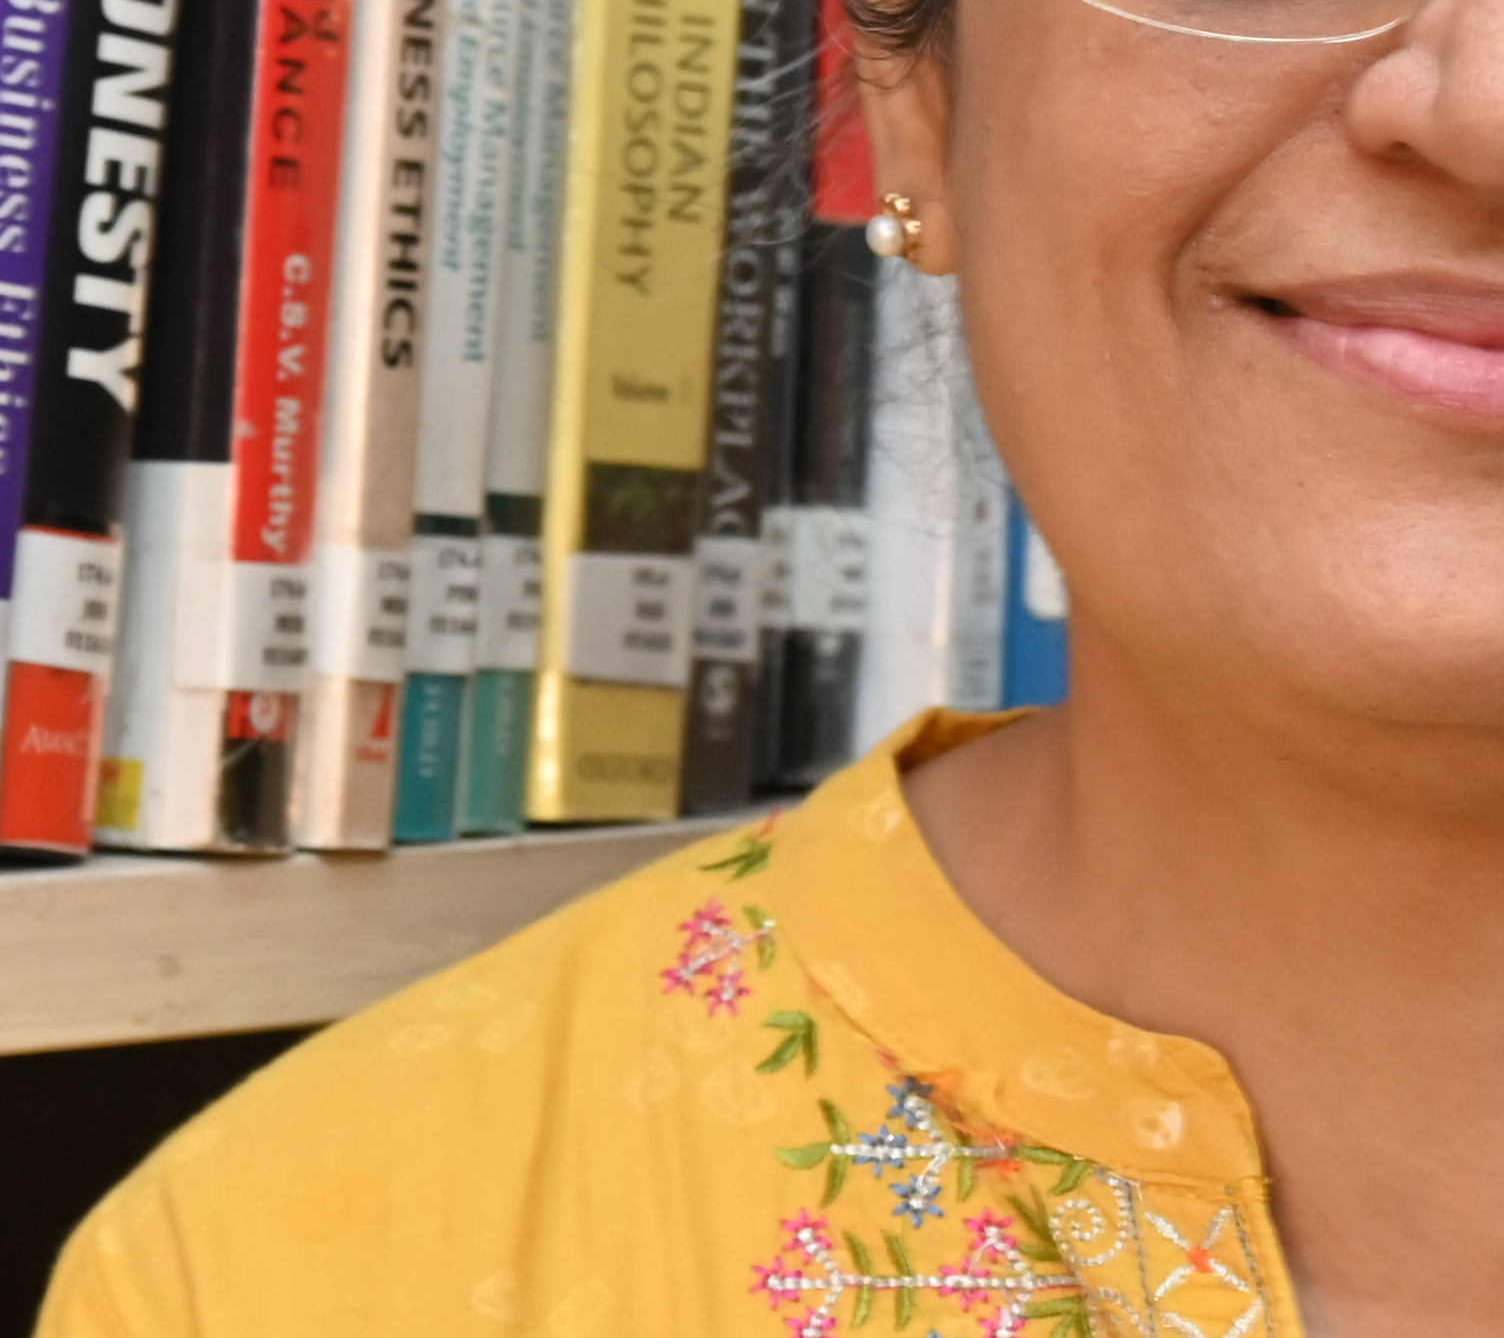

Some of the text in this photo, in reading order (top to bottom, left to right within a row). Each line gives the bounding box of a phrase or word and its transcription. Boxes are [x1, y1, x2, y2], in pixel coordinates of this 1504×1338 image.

[667, 14, 717, 226] INDIAN
[380, 161, 424, 371] ETHICS
[259, 397, 305, 559] Murthy
